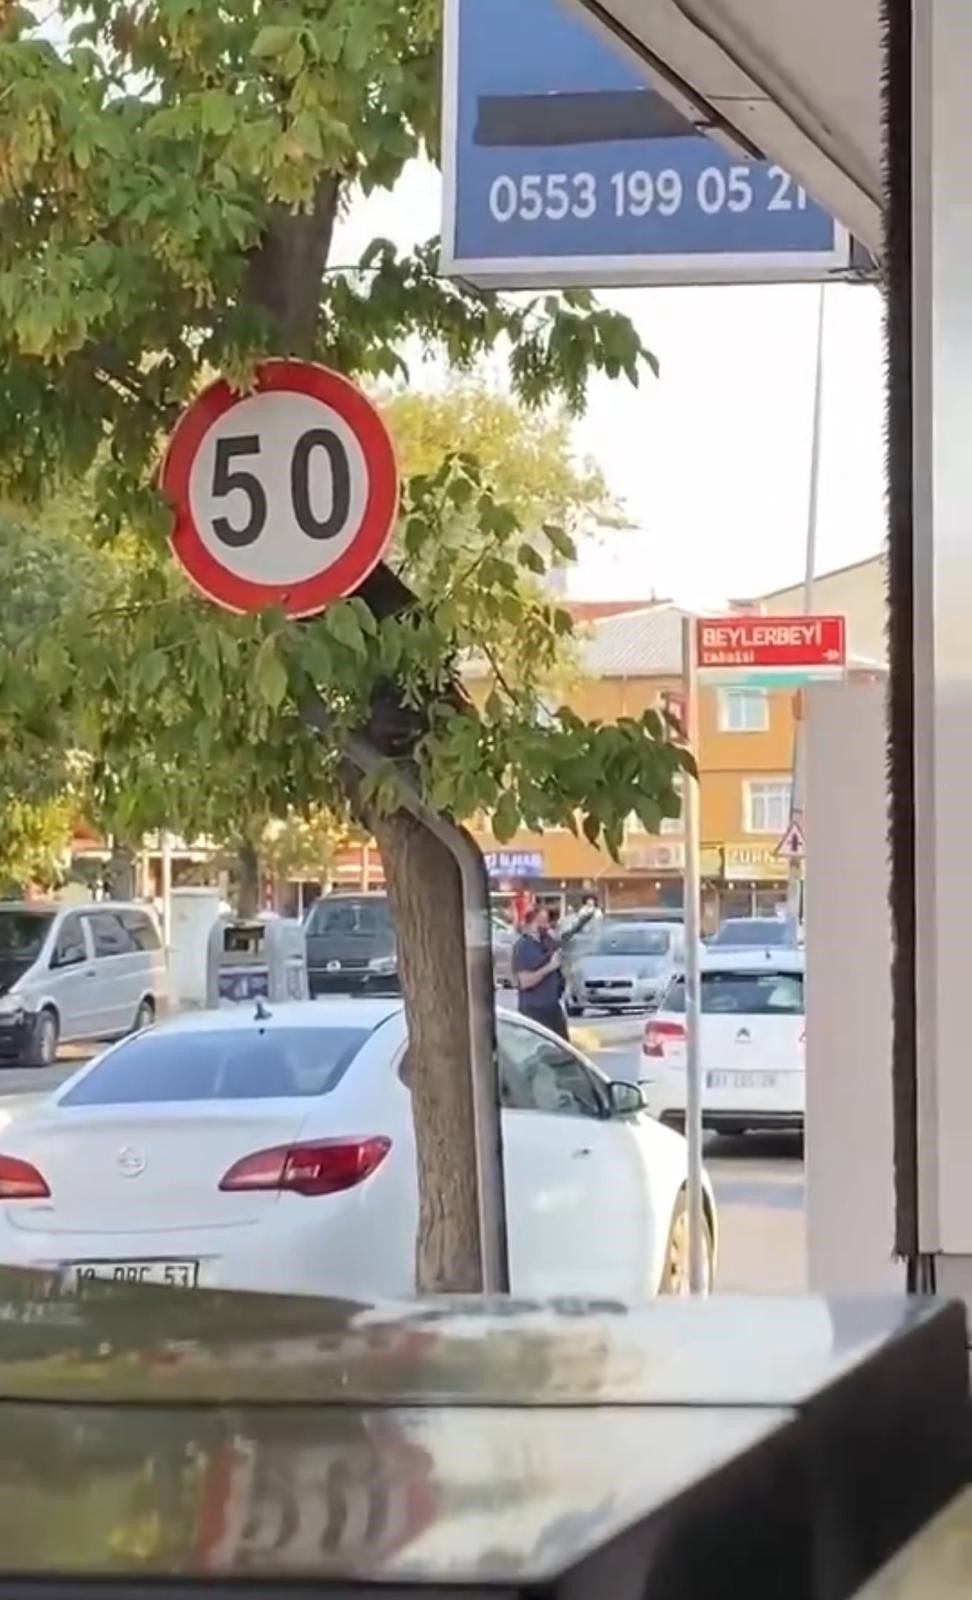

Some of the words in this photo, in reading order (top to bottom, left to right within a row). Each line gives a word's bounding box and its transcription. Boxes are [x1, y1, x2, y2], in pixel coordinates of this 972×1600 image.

[488, 172, 598, 222] 0553
[609, 168, 684, 217] 199
[696, 165, 753, 214] 05
[211, 428, 352, 548] 50
